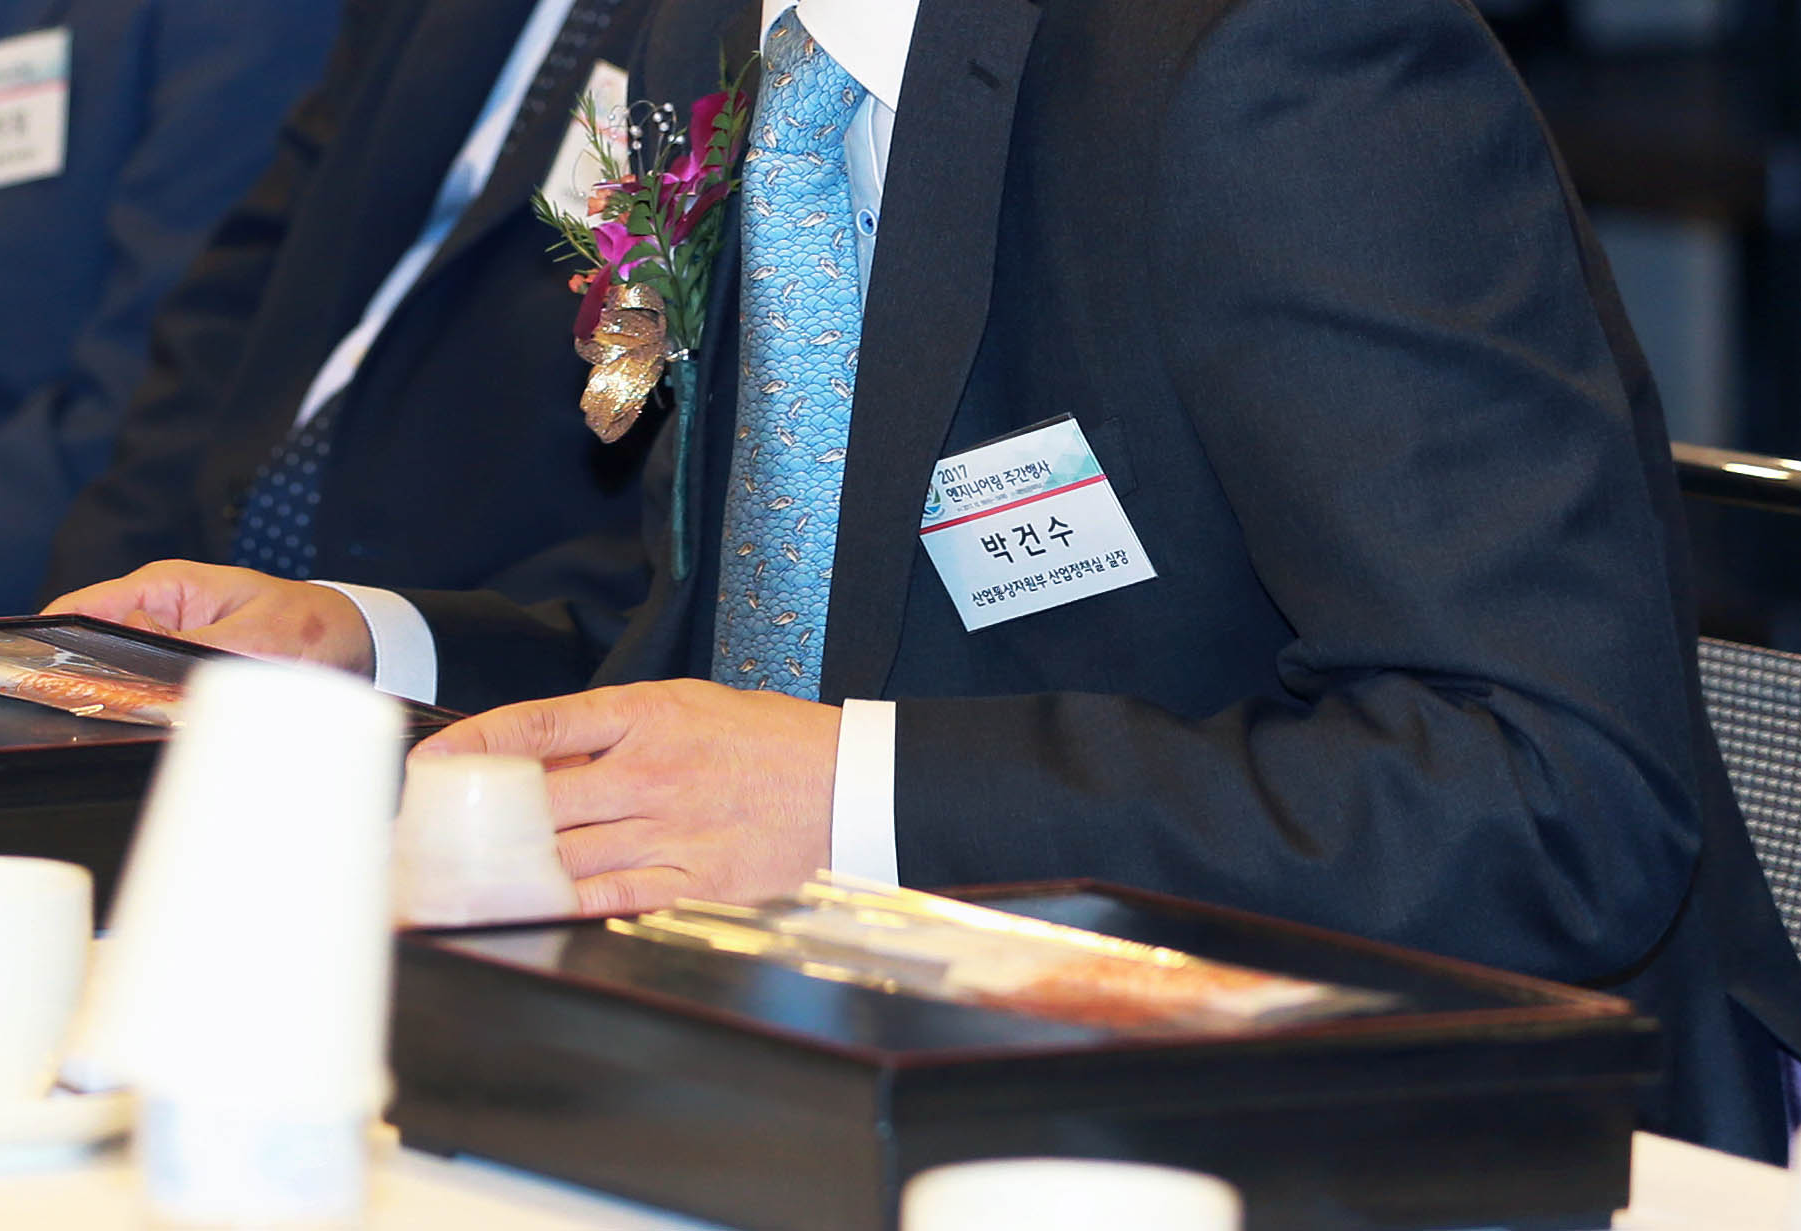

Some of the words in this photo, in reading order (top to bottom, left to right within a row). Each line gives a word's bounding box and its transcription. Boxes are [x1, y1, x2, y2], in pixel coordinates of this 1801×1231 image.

[938, 464, 968, 484] 2017
[946, 474, 1004, 502] 엔지니어링
[1003, 460, 1052, 486] 주간행사
[980, 516, 1074, 563] 박건수
[972, 574, 1048, 606] 산업통상자원부
[1049, 556, 1106, 585] 산업정책실
[1105, 550, 1129, 569] 실장
